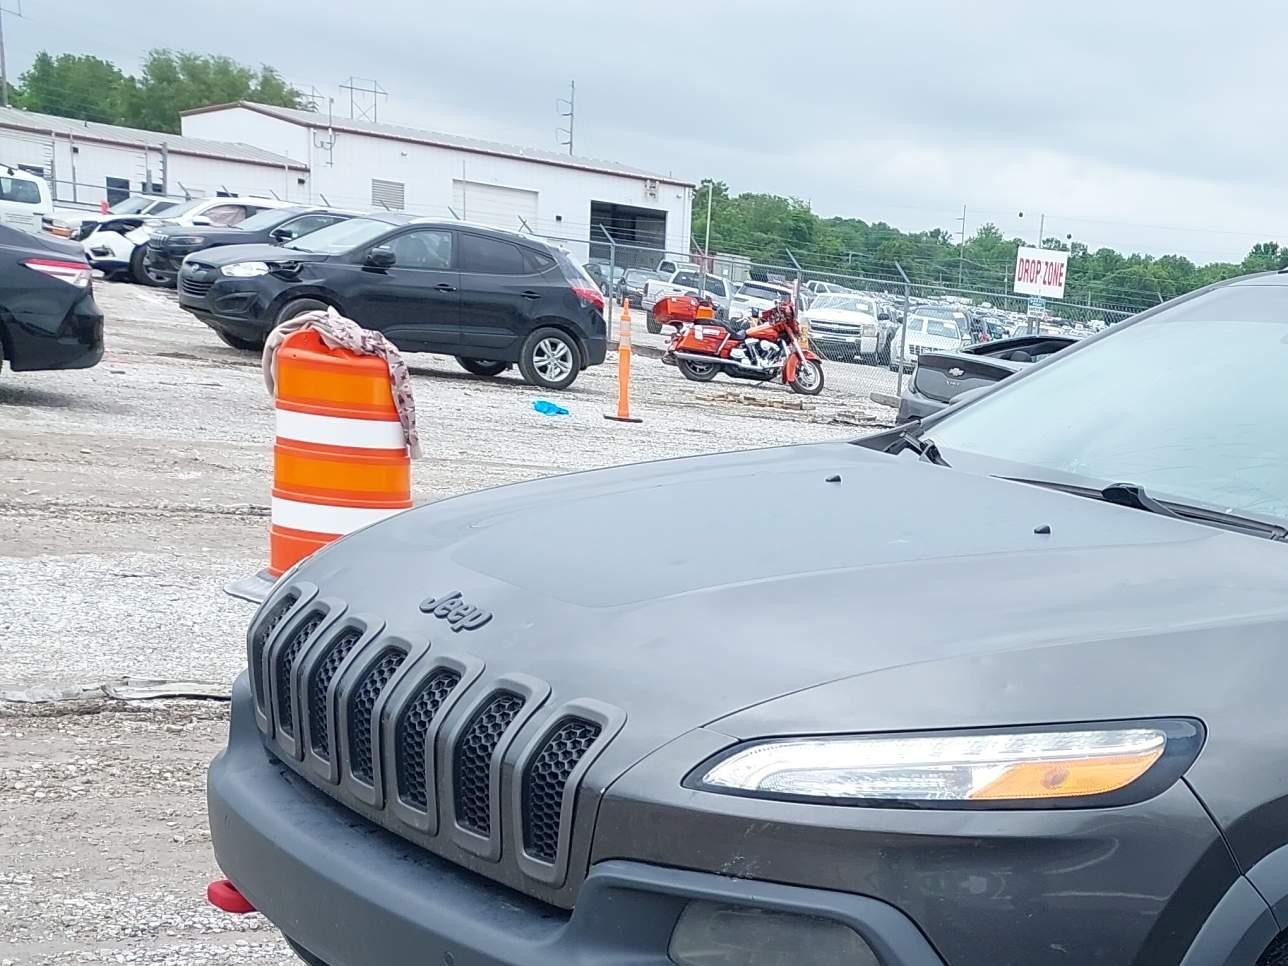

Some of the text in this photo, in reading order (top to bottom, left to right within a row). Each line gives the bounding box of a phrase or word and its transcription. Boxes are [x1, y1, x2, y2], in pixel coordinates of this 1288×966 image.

[1017, 258, 1064, 287] DROP ZONE
[419, 591, 493, 632] Jeep
